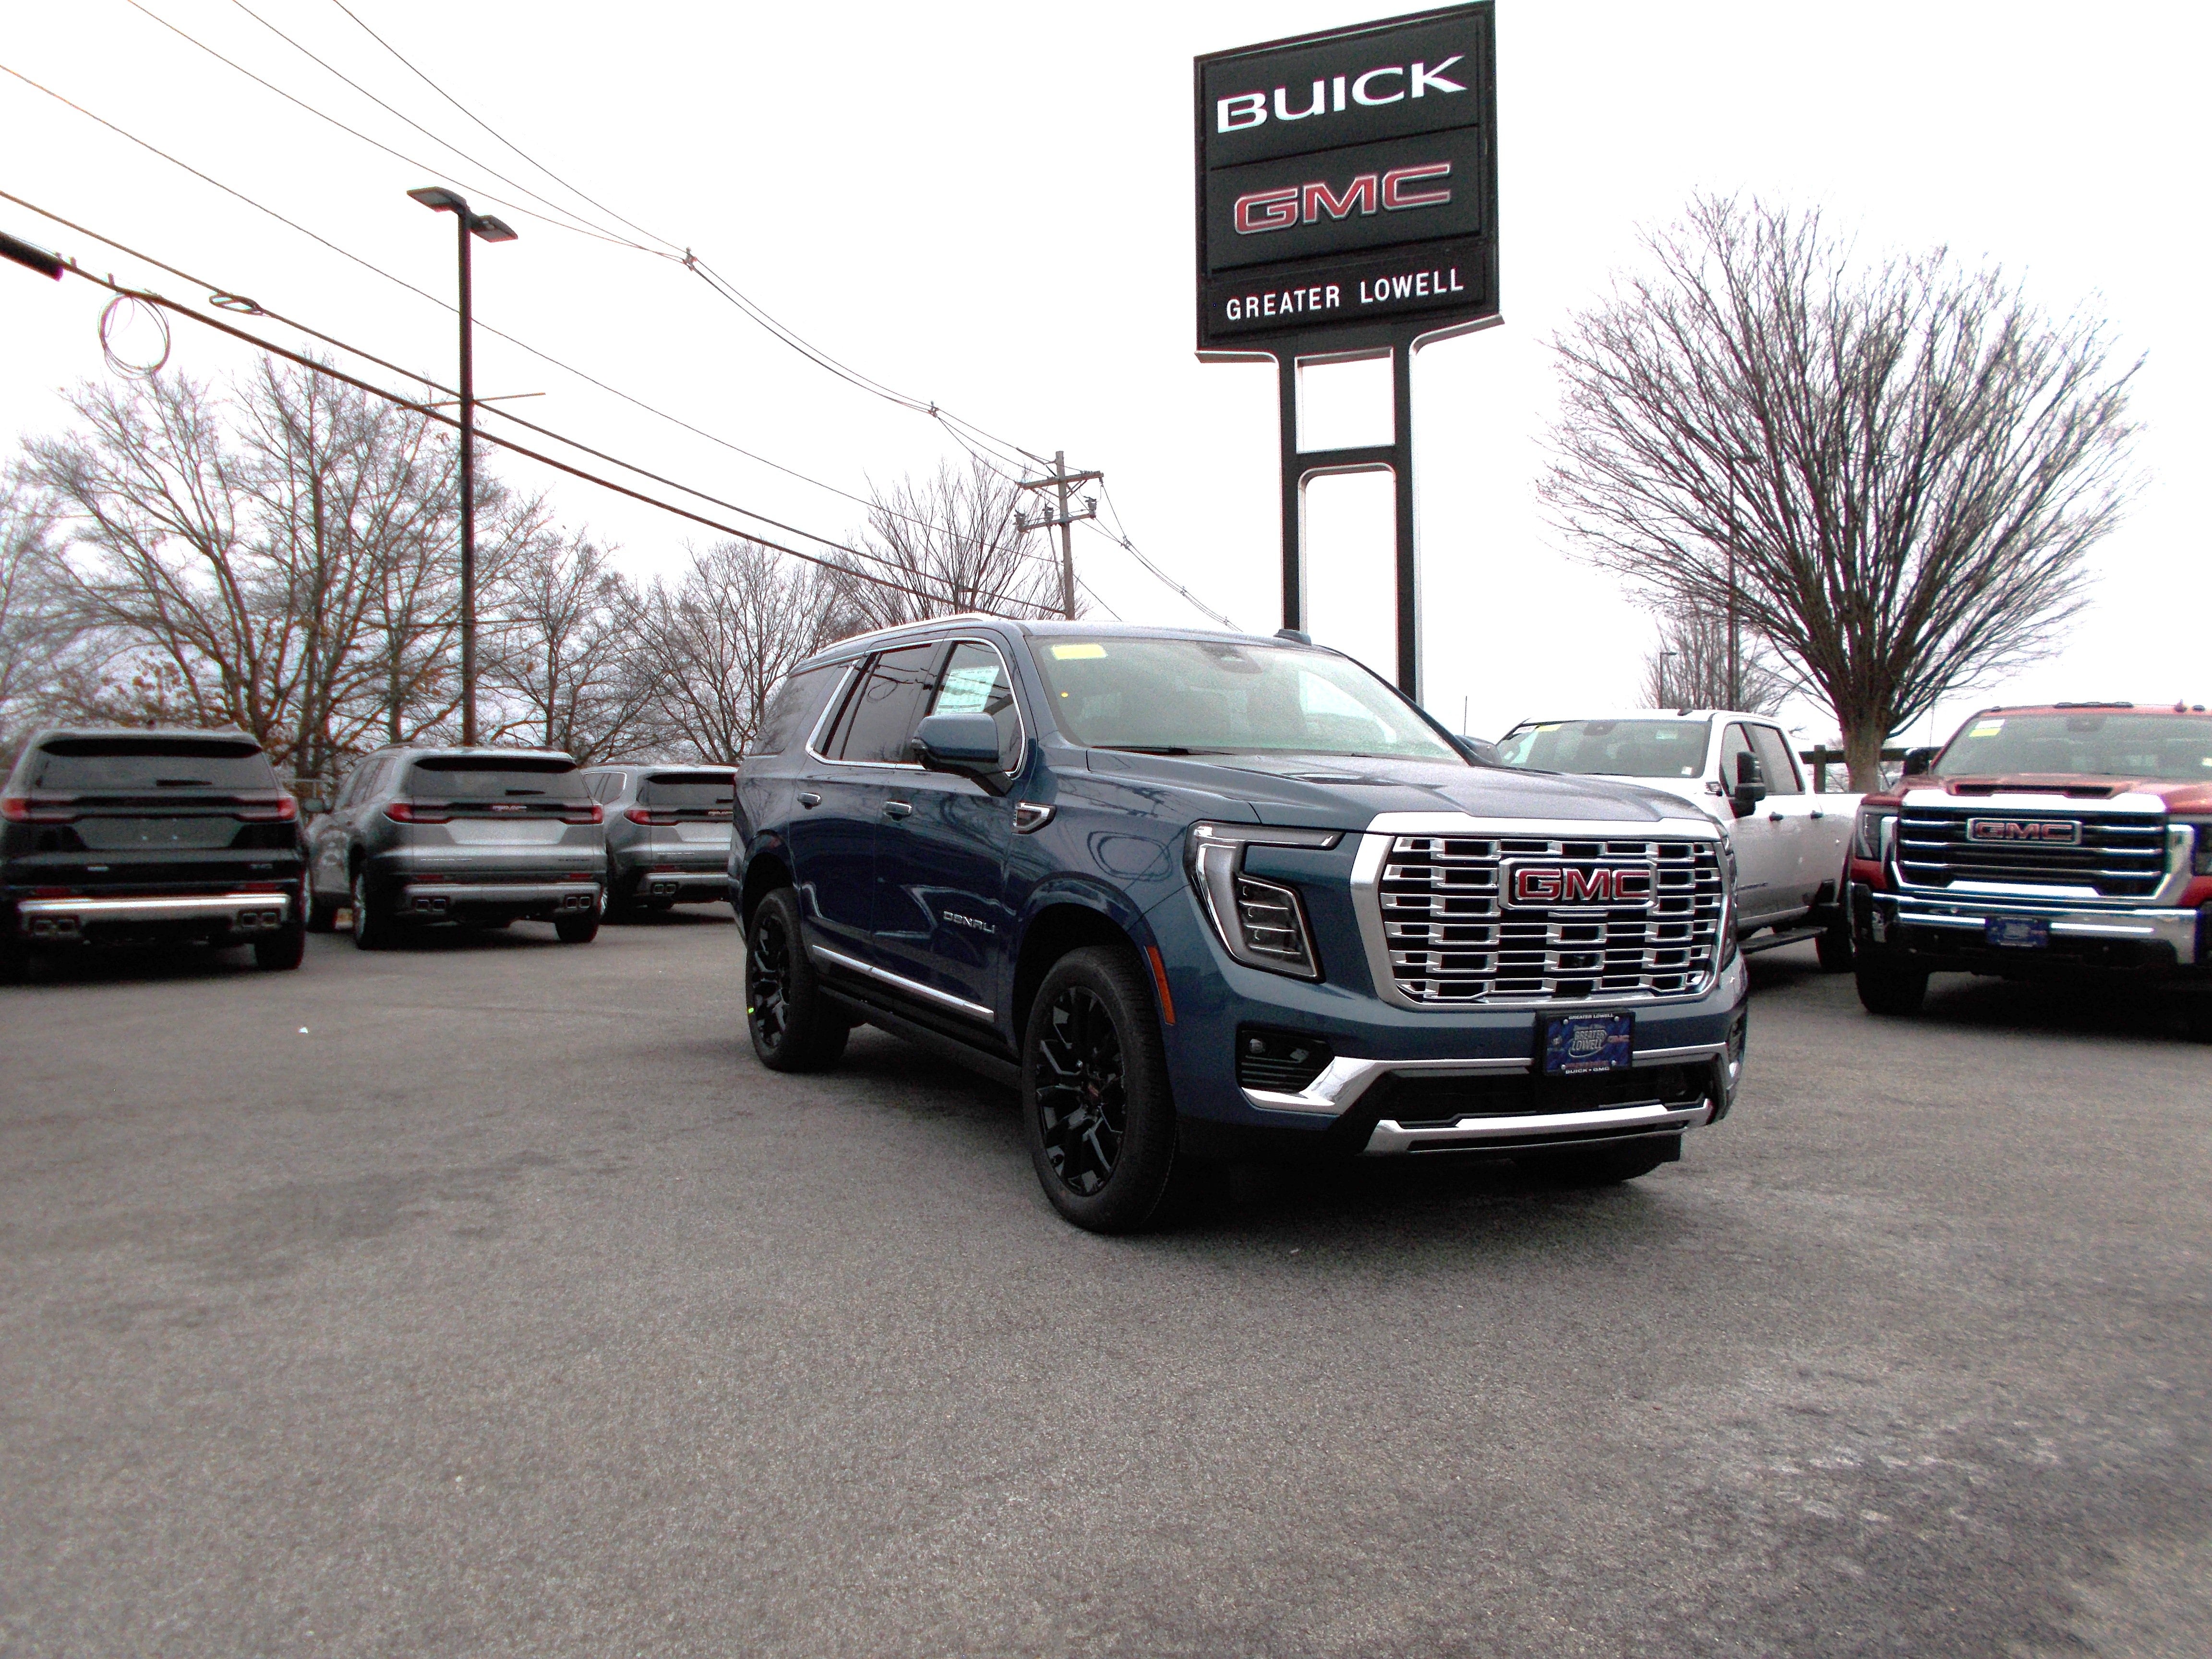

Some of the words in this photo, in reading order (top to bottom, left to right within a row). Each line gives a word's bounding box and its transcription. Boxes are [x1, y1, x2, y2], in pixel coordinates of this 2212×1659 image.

[1217, 55, 1468, 133] BUICK
[1234, 161, 1451, 235] GMC
[1226, 286, 1340, 321] GREATER
[1360, 268, 1465, 304] LOWELL
[1976, 822, 2073, 841] GMC
[1515, 868, 1651, 901] GMC
[943, 911, 995, 934] DENALI
[1572, 1039, 1602, 1051] LOWELL
[1574, 1030, 1605, 1041] GREATER
